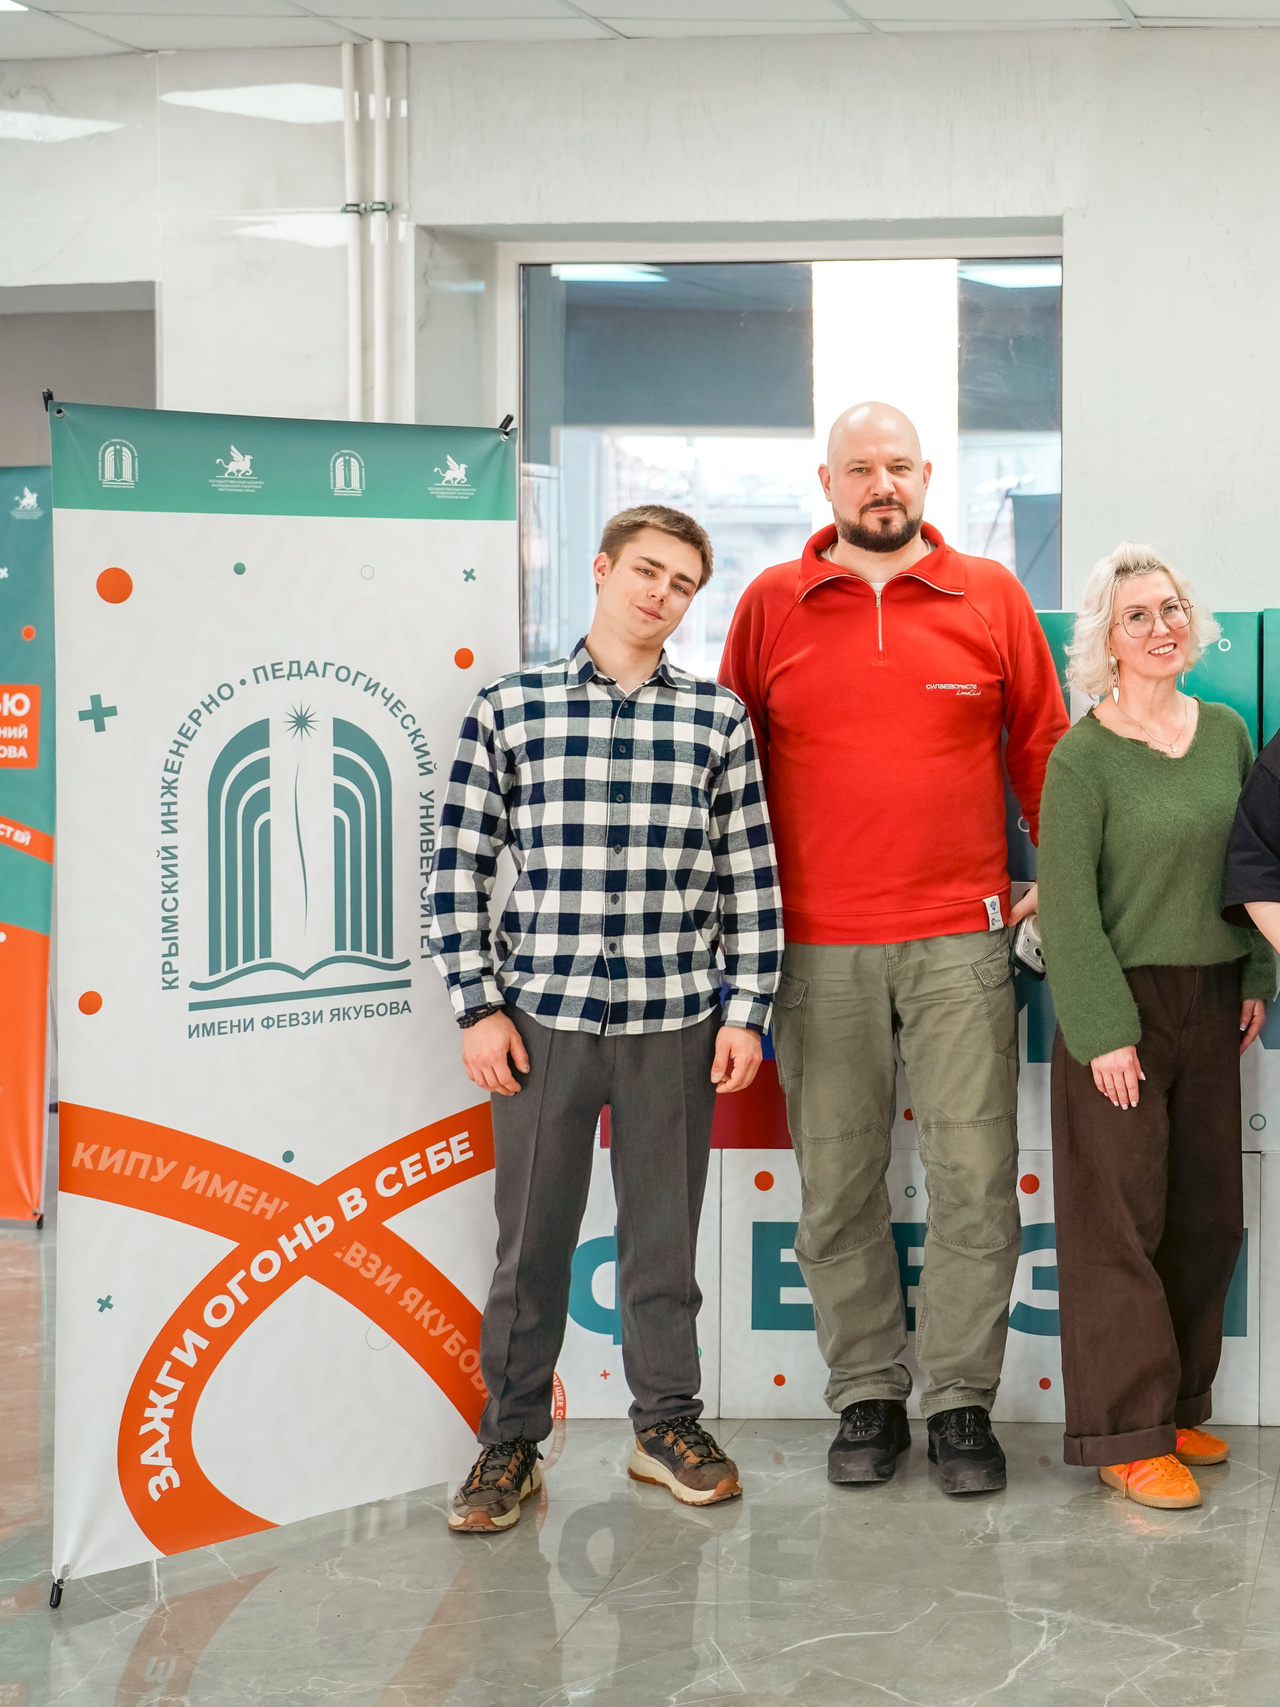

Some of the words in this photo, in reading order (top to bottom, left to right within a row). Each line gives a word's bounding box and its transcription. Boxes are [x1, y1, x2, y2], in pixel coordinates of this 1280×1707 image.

[160, 682, 235, 835] ИНЖЕНЕРНО
[252, 660, 438, 777] ПЕДАГОГИЧЕСКИЙ
[156, 845, 179, 991] КРЫМСКИЙ
[188, 1017, 255, 1039] ИМЕНИ
[260, 1010, 323, 1030] ФЕВЗИ
[329, 1000, 412, 1023] ЯКУБОВА
[71, 1141, 179, 1182] КИПУ
[181, 1165, 290, 1221] ИМЕН
[138, 1328, 210, 1502] ЗАЖГИ
[203, 1214, 335, 1328] ОГОНЬ
[337, 1187, 368, 1222] В
[375, 1130, 474, 1198] СЕБЕ
[333, 1240, 403, 1295] ВЗИ
[398, 1286, 489, 1399] ЯКУБОВ
